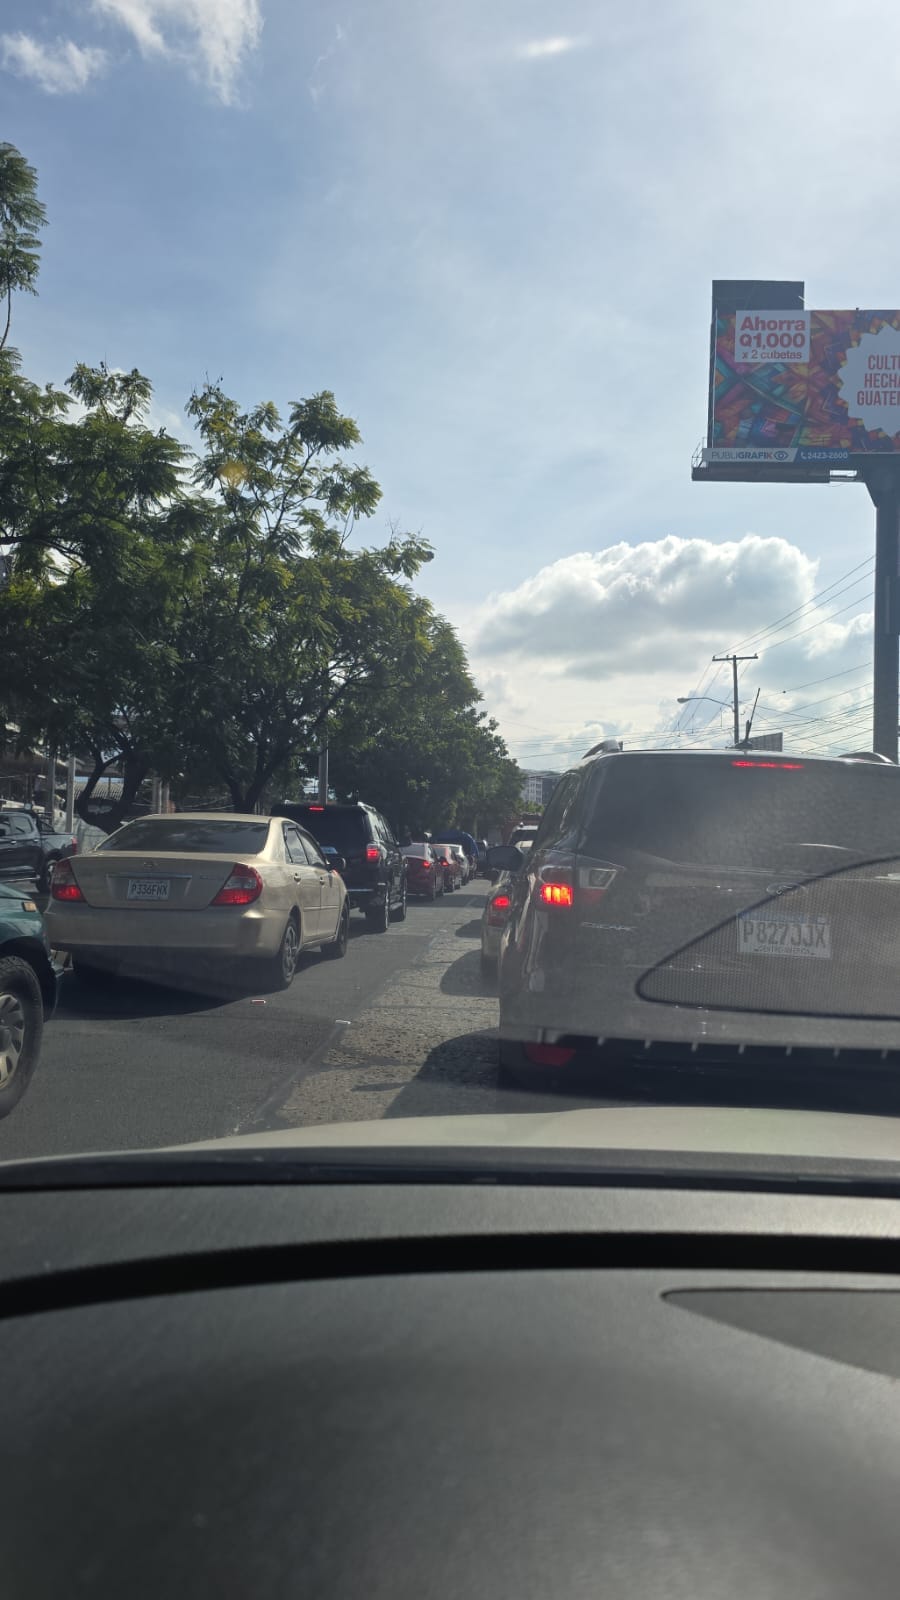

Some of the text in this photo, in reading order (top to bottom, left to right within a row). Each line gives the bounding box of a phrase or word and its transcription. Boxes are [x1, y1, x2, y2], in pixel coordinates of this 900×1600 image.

[740, 316, 806, 331] Ahorra
[739, 332, 806, 350] Q1,000
[751, 349, 758, 359] 2
[760, 350, 802, 360] cubetas
[711, 450, 773, 460] PUBLIGRAFIK
